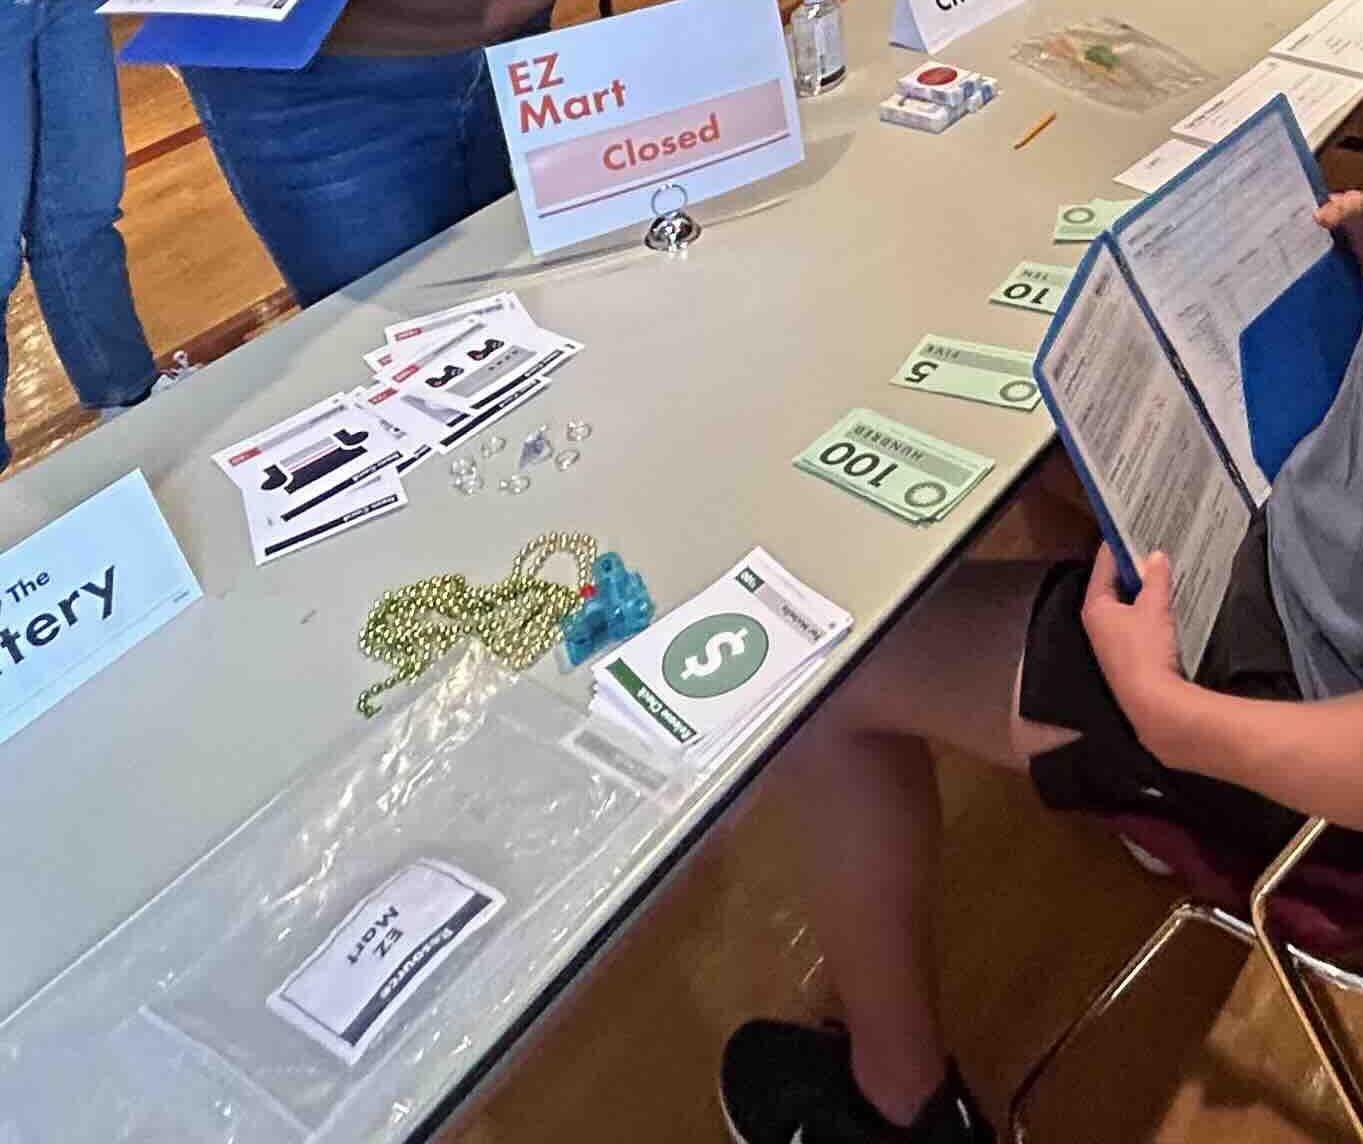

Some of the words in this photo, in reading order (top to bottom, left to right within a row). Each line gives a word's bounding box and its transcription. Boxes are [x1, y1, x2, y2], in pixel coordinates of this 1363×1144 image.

[507, 52, 564, 97] EZ
[519, 79, 626, 134] Mart
[602, 112, 721, 172] Closed
[1003, 282, 1050, 305] 10
[904, 360, 938, 384] 5
[819, 441, 899, 488] 100
[5, 570, 51, 604] The
[0, 564, 115, 667] tery
[346, 906, 400, 965] Mart
[372, 927, 404, 958] EZ
